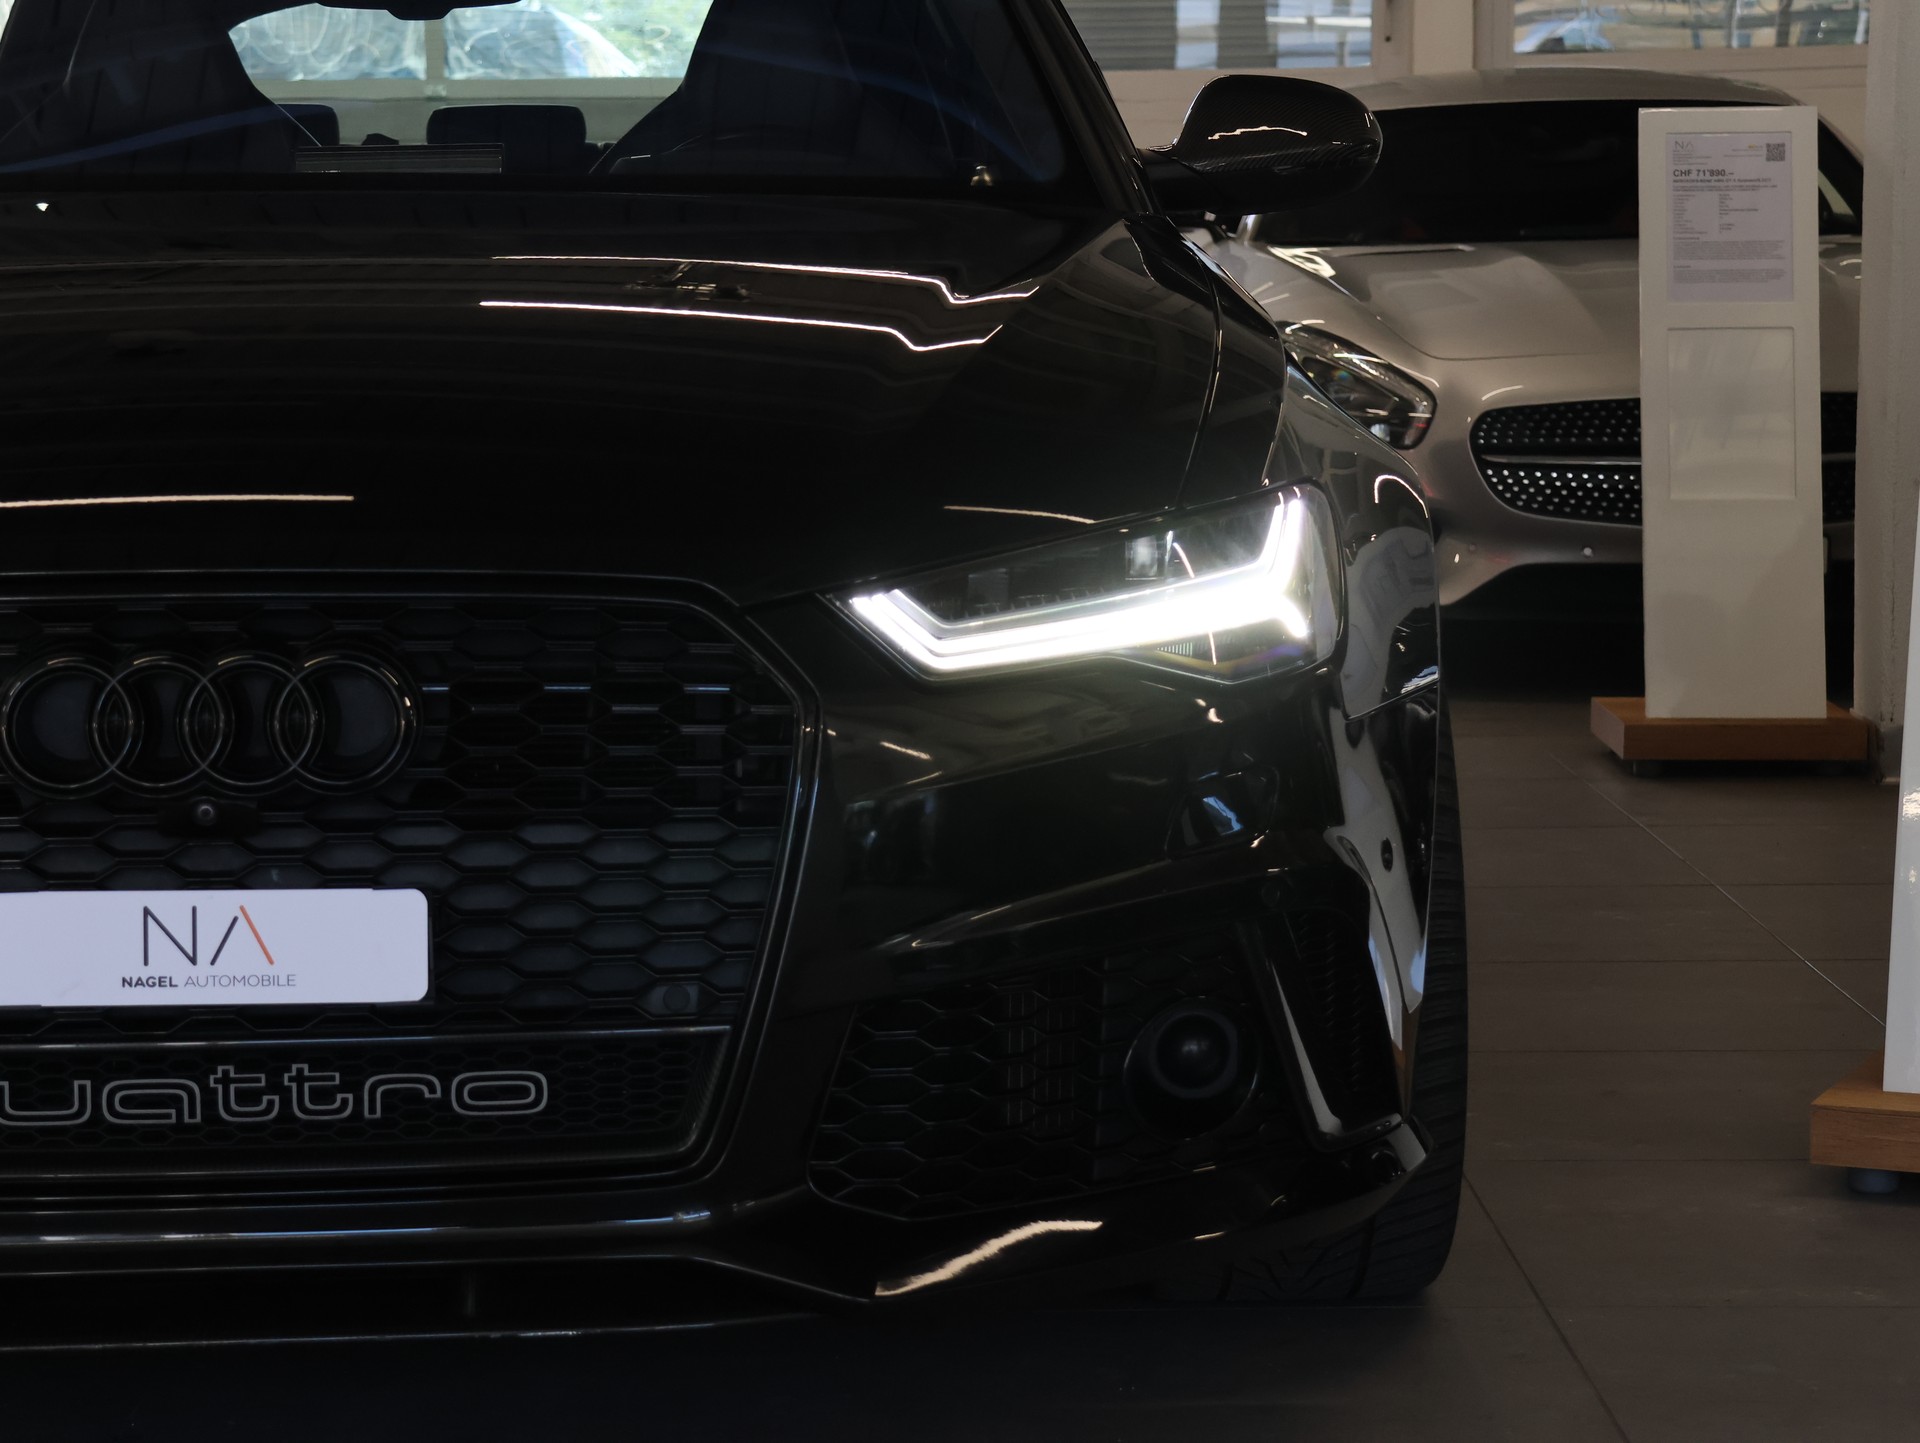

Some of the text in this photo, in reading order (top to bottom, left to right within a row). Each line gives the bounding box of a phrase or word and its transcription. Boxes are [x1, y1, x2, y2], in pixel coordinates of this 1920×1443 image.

[1673, 168, 1693, 177] CHF
[121, 973, 297, 989] NAGEL AUTOMOBILE
